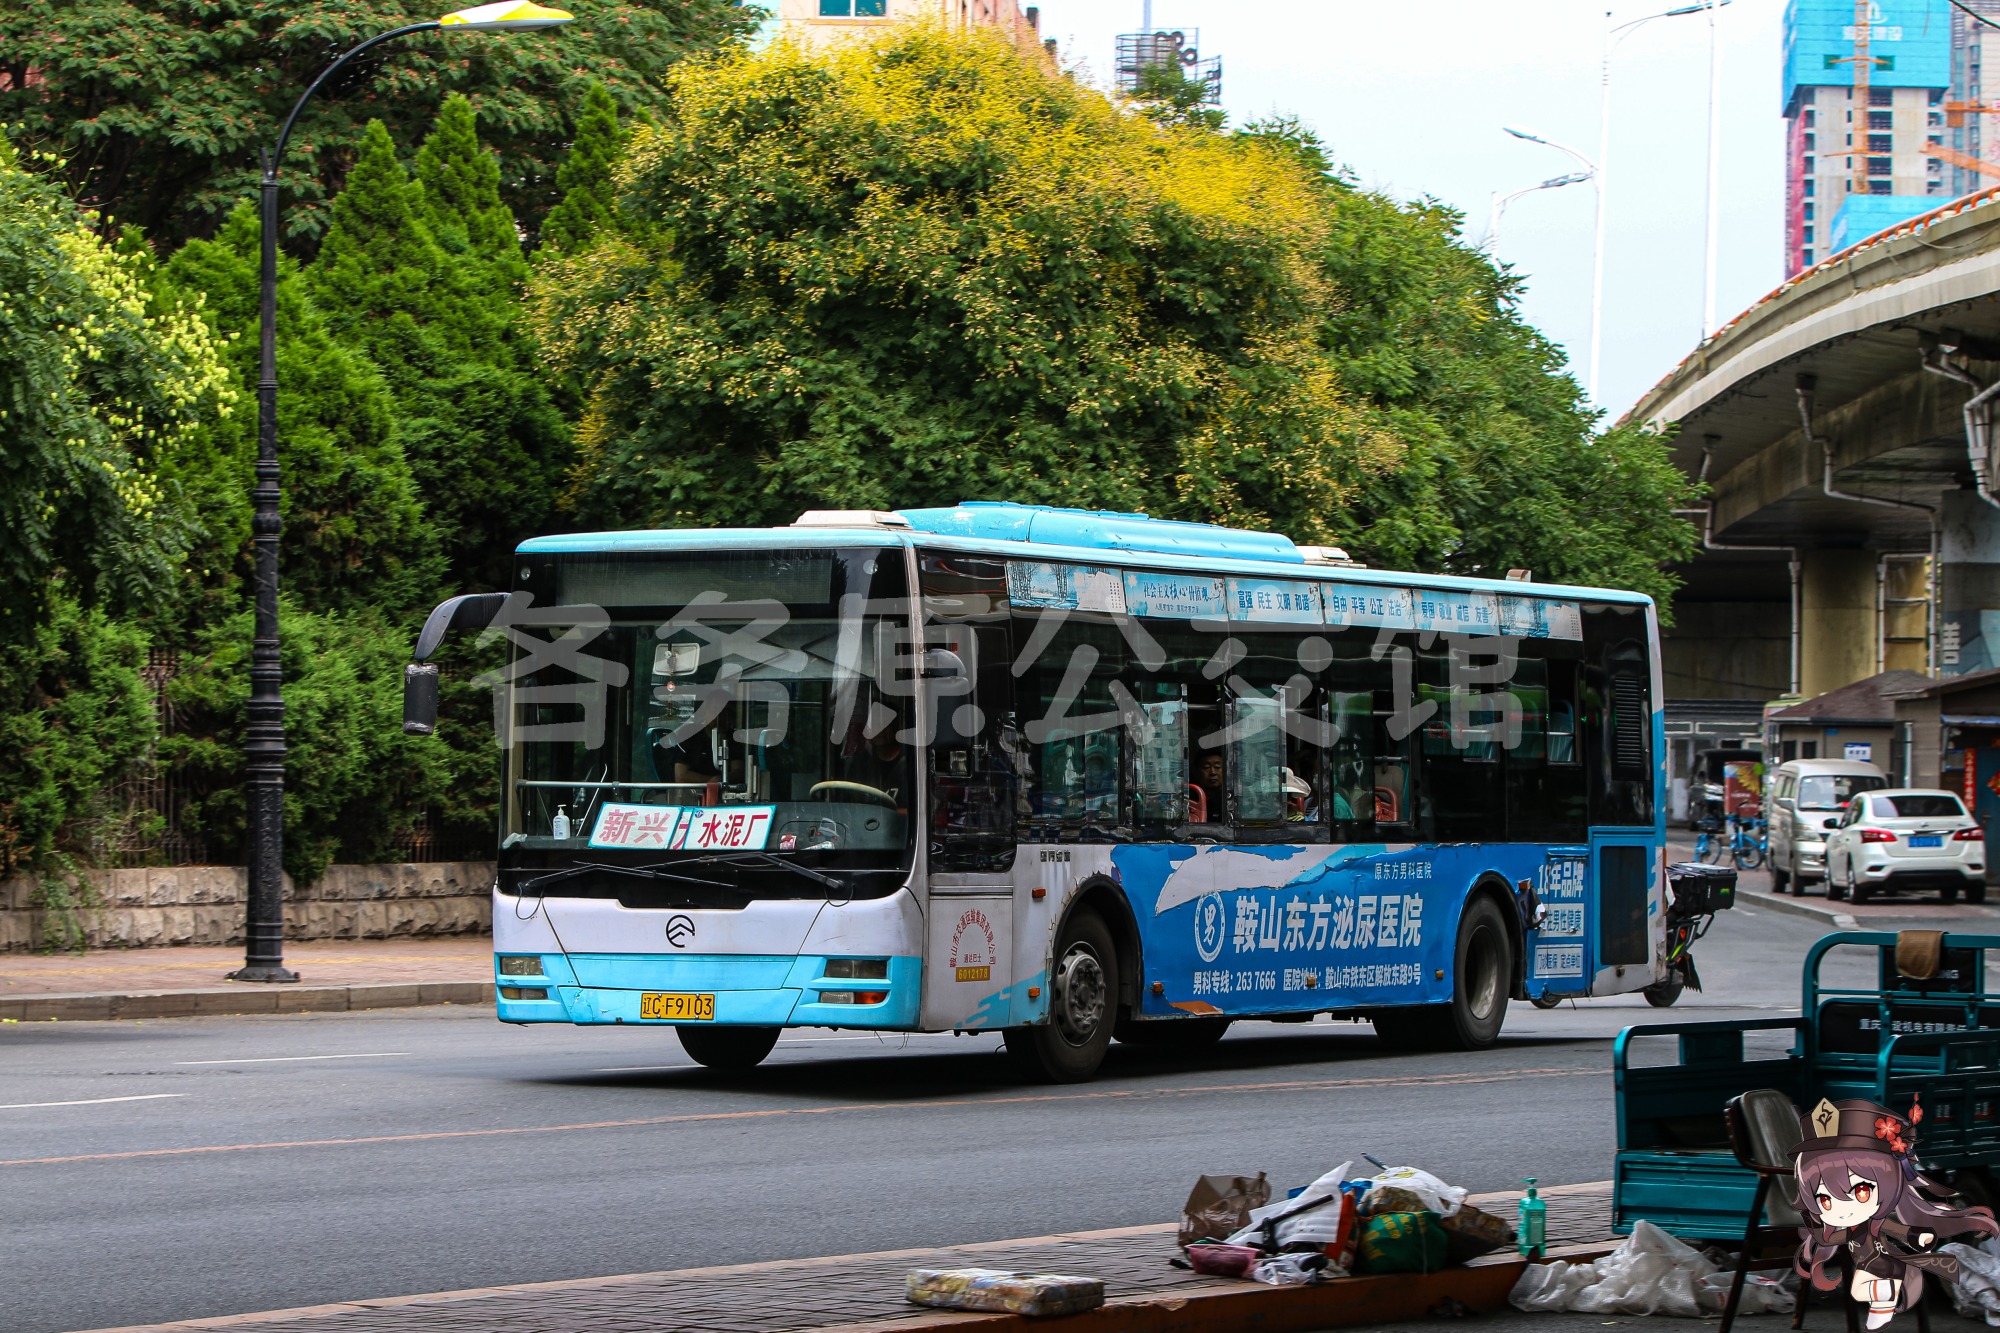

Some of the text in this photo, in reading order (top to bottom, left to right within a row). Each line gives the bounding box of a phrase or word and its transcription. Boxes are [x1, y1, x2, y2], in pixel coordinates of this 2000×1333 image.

[1143, 580, 1209, 602] 社会主义核心价值观
[1238, 590, 1310, 611] 富强 民主 文明 和谐
[1333, 595, 1402, 617] 自由 平等 公正 法治
[1421, 602, 1489, 624] 爱国 敬业 诚信 友善
[599, 809, 671, 844] 新兴
[698, 813, 768, 848] 水泥厂
[1374, 862, 1432, 880] 原东方男科医院
[1233, 892, 1423, 953] 鞍山东方泌尿医院
